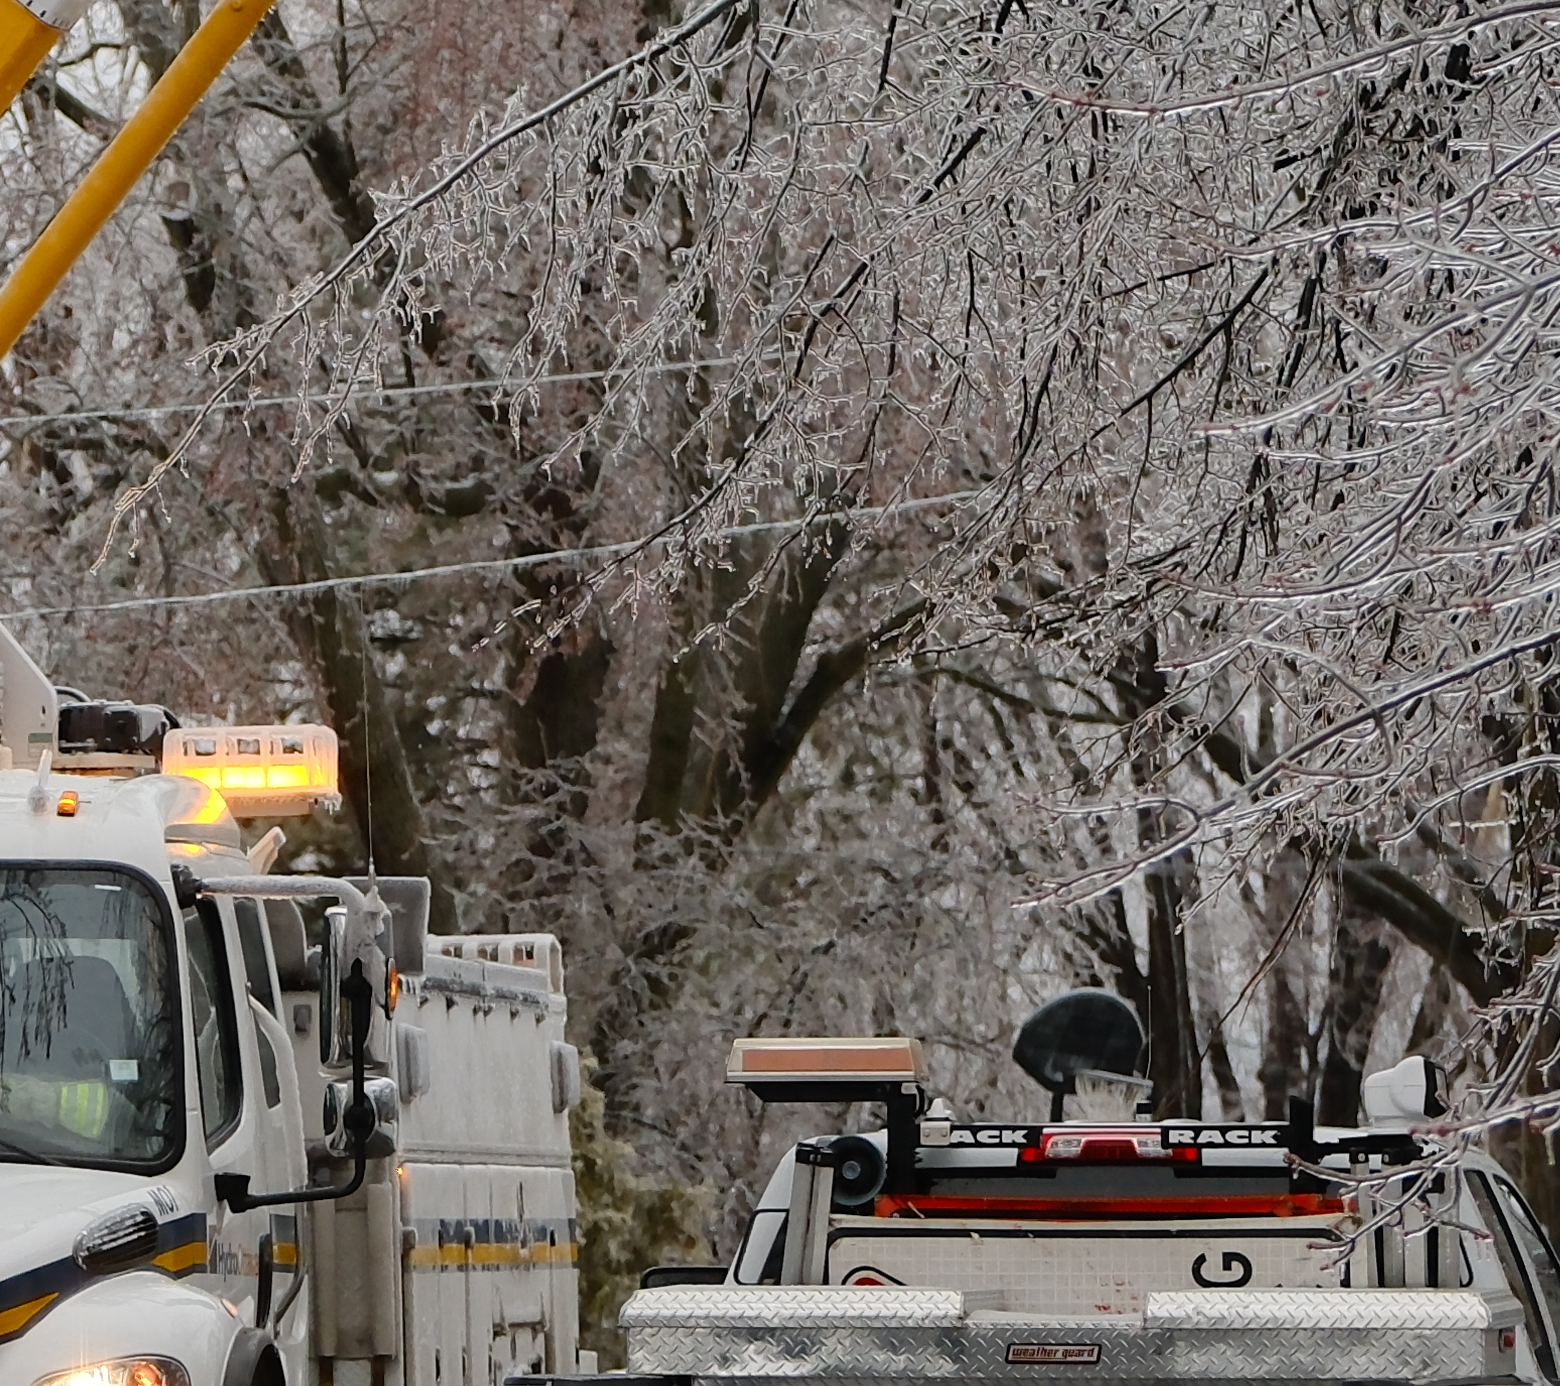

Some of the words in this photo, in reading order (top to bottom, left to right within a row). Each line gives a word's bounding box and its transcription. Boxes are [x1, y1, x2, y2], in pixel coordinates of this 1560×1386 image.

[950, 1129, 1028, 1144] ACK
[1168, 1129, 1279, 1144] RACK
[1012, 1347, 1060, 1358] weather
[1061, 1347, 1095, 1359] guard
